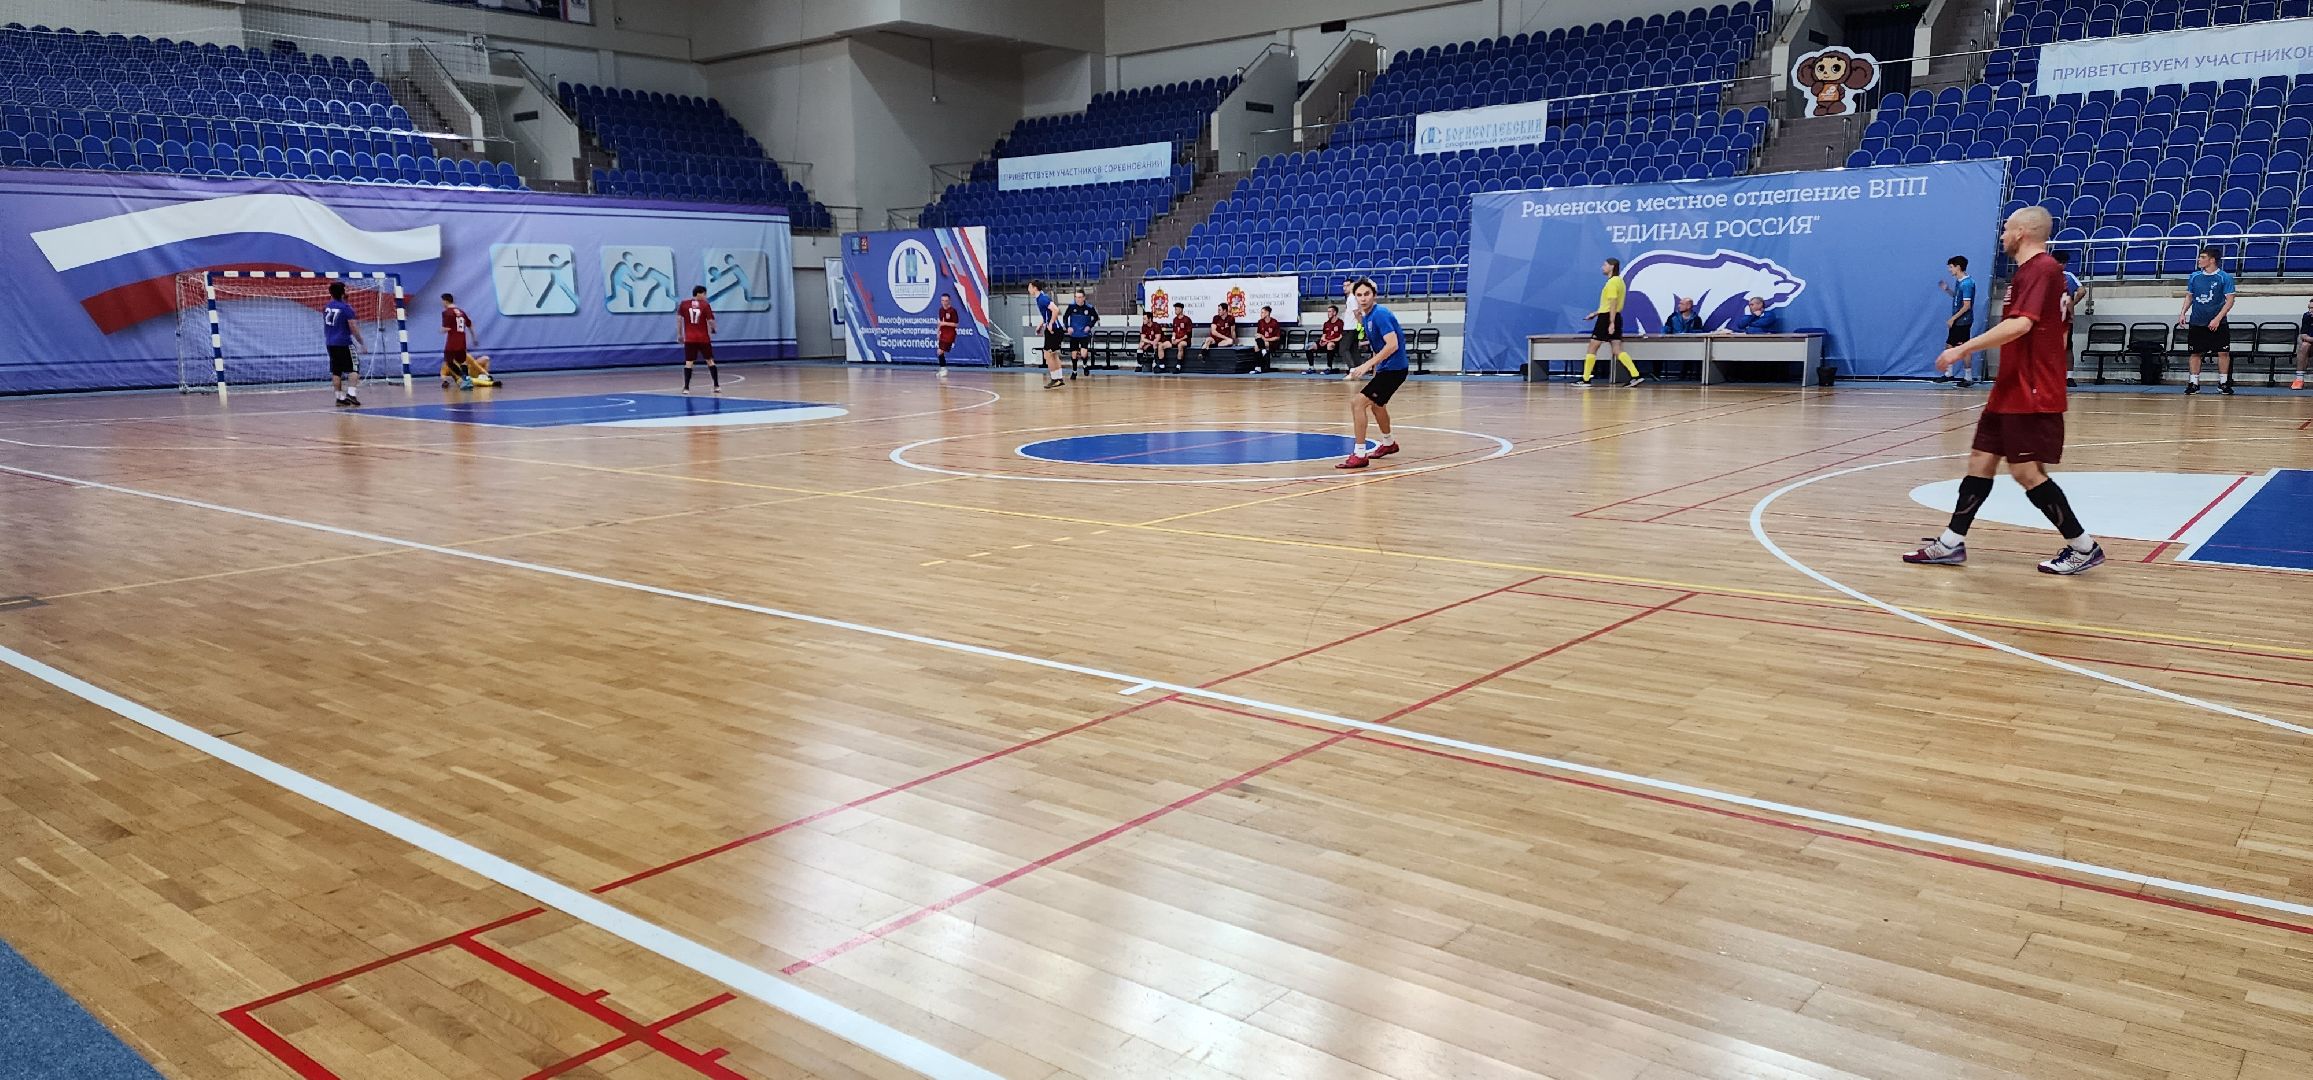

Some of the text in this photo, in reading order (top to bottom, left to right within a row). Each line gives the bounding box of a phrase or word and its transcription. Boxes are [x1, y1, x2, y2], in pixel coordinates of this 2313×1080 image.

[2053, 57, 2189, 80] ПРИВЕТСТВУЕМ
[1003, 171, 1055, 182] ПРИВЕТСТВУЕМ
[1057, 165, 1102, 178] УЧАСТНИКОВ
[1521, 176, 1929, 218] Раменское местное отделение ВПП
[325, 307, 340, 326] 27
[689, 307, 701, 324] 17
